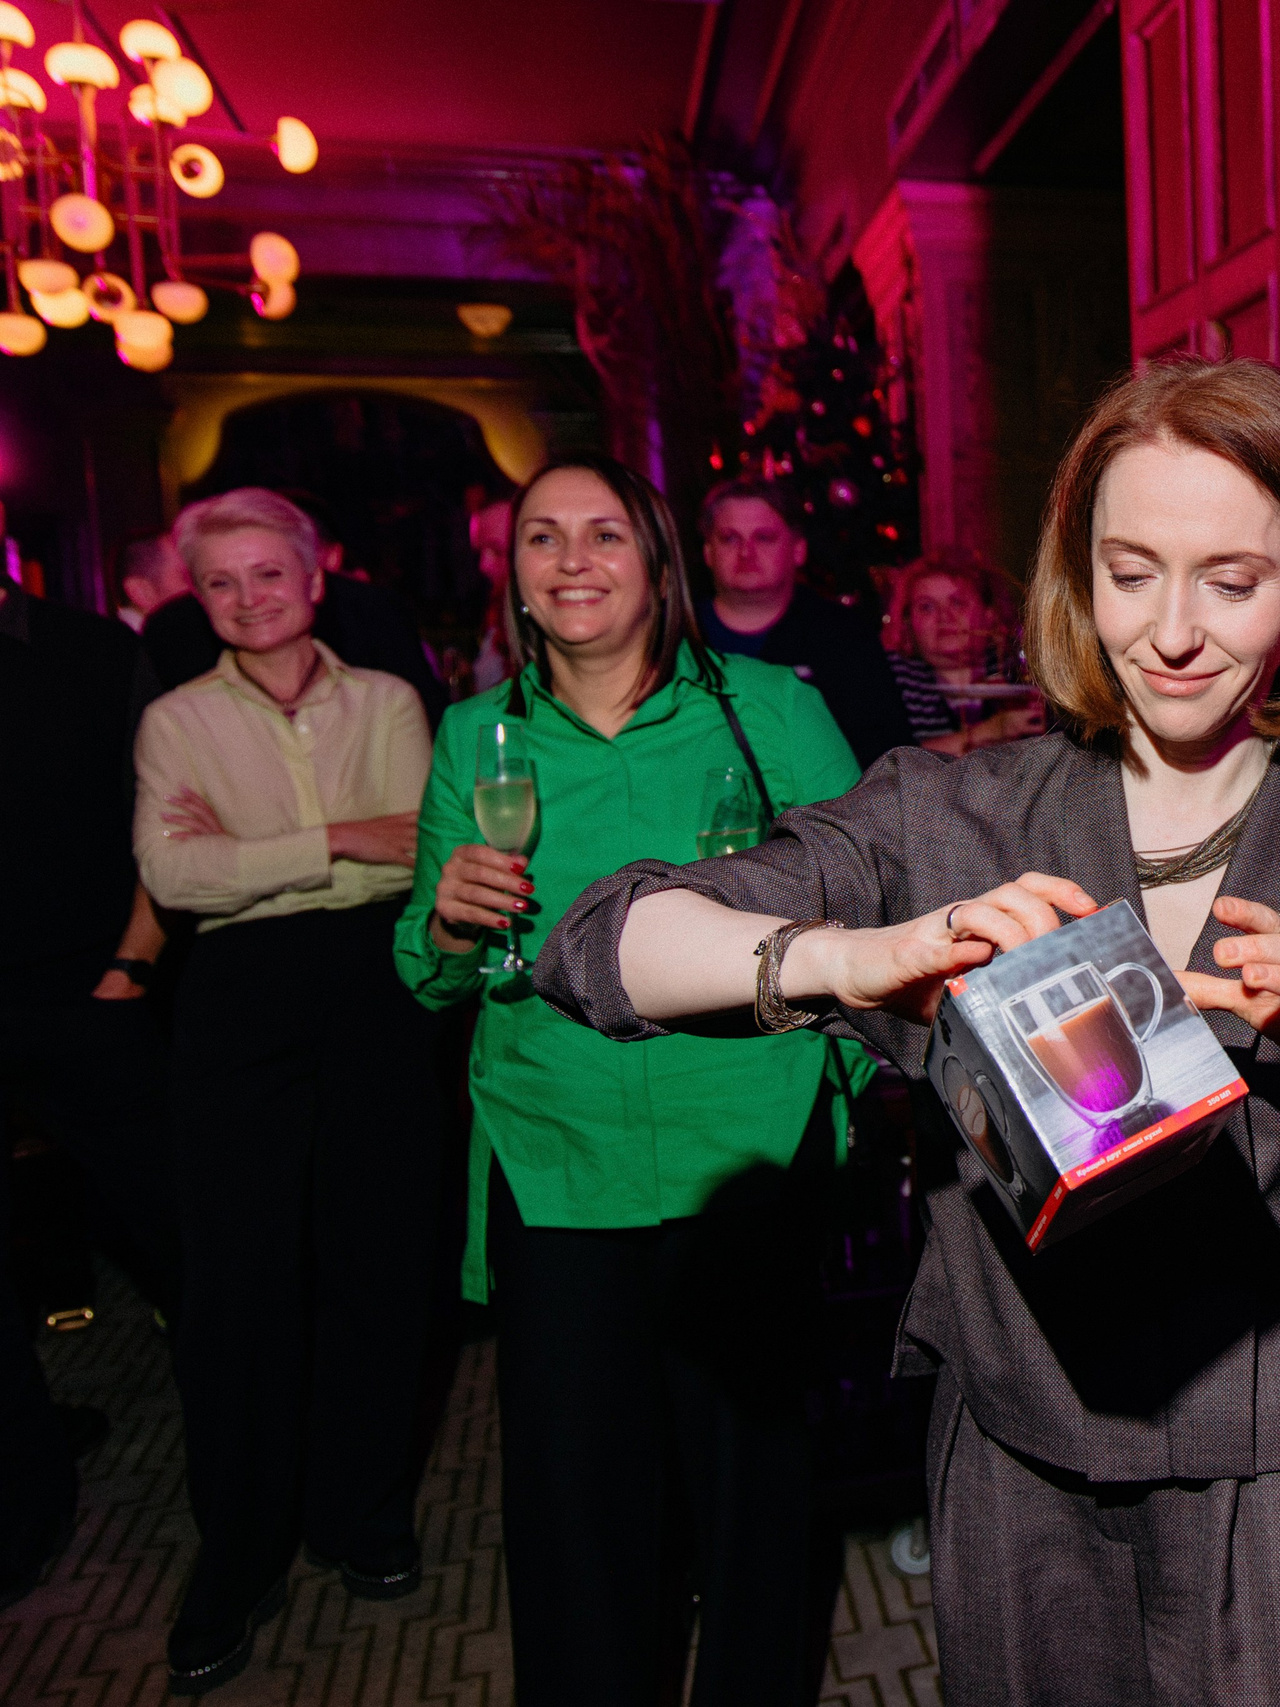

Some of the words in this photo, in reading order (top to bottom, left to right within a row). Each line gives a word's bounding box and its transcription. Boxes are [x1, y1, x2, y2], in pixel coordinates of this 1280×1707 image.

[1207, 1094, 1221, 1107] 350
[1076, 1158, 1106, 1178] Кращий
[1106, 1149, 1122, 1163] друг
[1144, 1126, 1163, 1143] кухні
